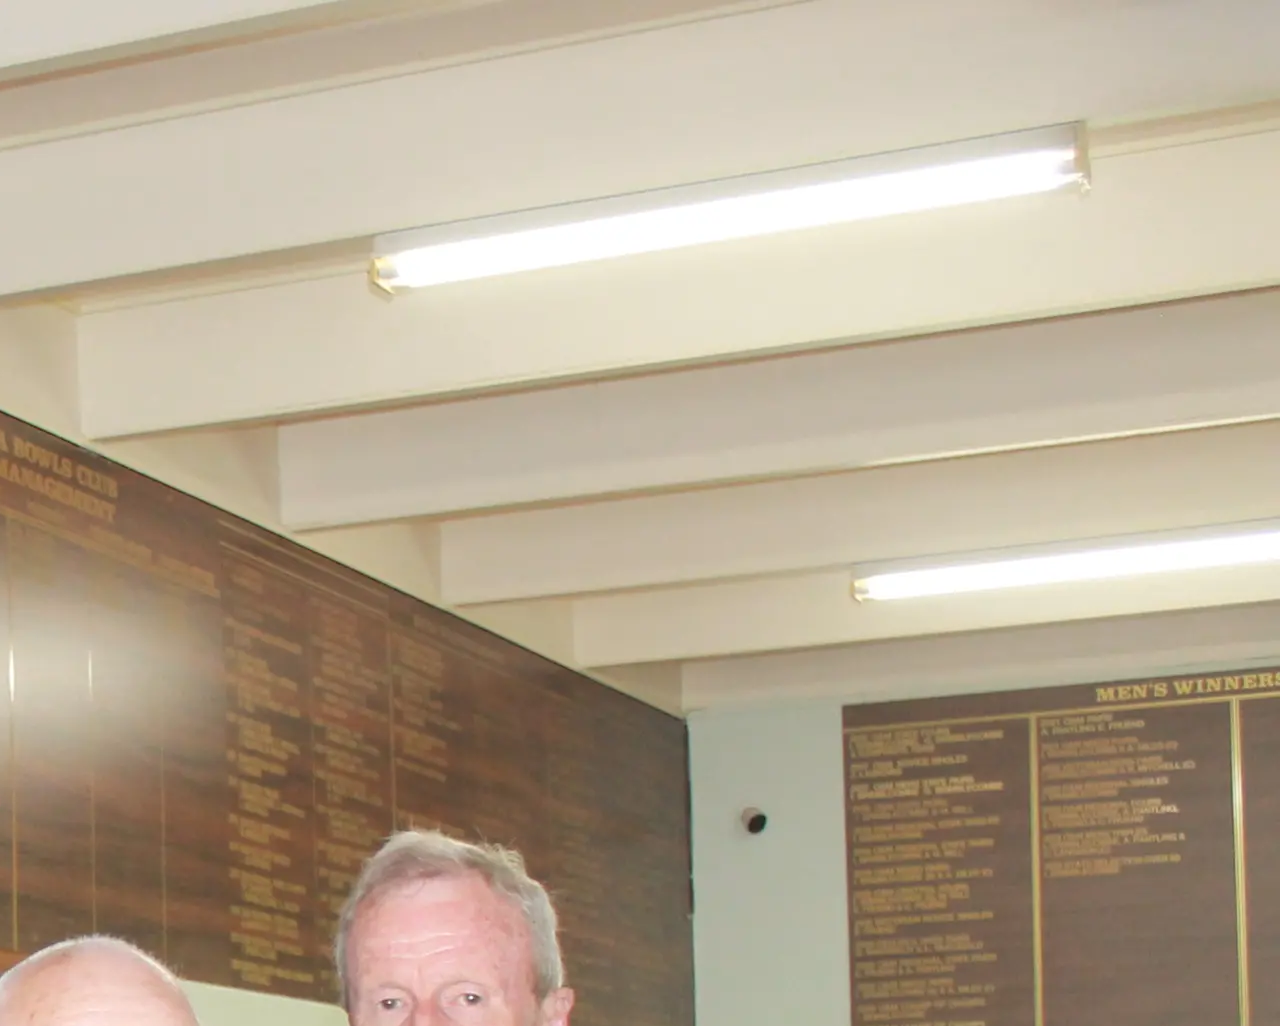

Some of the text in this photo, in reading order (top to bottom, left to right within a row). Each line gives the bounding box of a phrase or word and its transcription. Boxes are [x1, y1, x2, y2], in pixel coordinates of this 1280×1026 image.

[12, 434, 74, 478] BOWLS
[75, 461, 120, 500] CLUB
[1095, 681, 1169, 703] MEN'S
